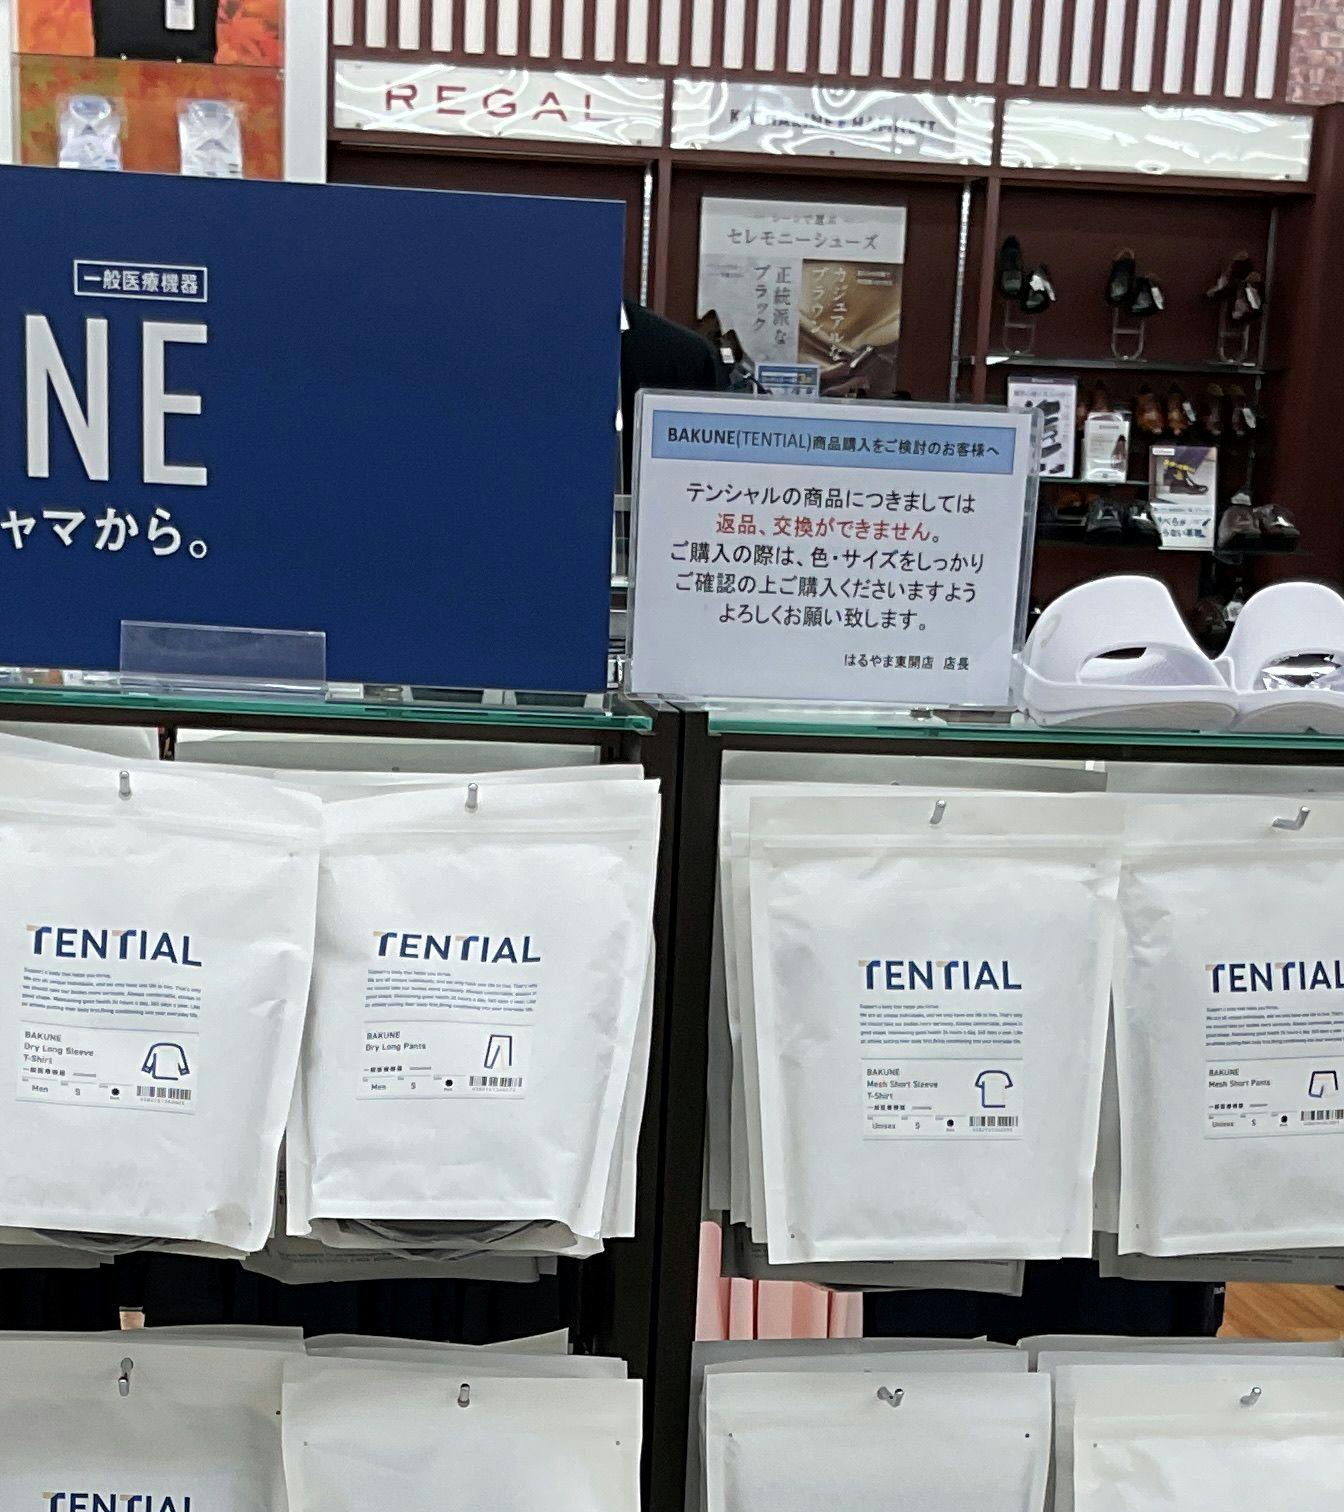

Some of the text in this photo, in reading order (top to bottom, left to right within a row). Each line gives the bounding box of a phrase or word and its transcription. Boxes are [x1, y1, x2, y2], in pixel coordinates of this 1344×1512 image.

[385, 83, 611, 122] REGAL
[727, 228, 879, 249] セレモニーシューズ
[83, 269, 198, 294] 一般医療機器
[667, 426, 1000, 458] BAKUNE(TENTIAL)商品購入をご検討のお客様へ
[686, 482, 976, 515] テンシャルの商品につきましては
[715, 513, 942, 543] 返品、交換ができません。
[670, 541, 984, 574] ご購入の際は、色・サイズをしっかり
[675, 572, 976, 603] ご確認の上ご購入くださいますよう
[718, 603, 926, 632] よろしくお願い致します。
[943, 656, 970, 671] 店長
[26, 924, 202, 966] TENTIAL
[373, 931, 540, 963] TENTIAL
[859, 960, 1022, 990] TENTIAL
[24, 1043, 94, 1056] Dry Long Sleeve
[25, 1032, 61, 1042] BAKUNE
[366, 1043, 379, 1052] Dry
[382, 1043, 401, 1051] Long
[23, 1054, 52, 1064] T-Shirt
